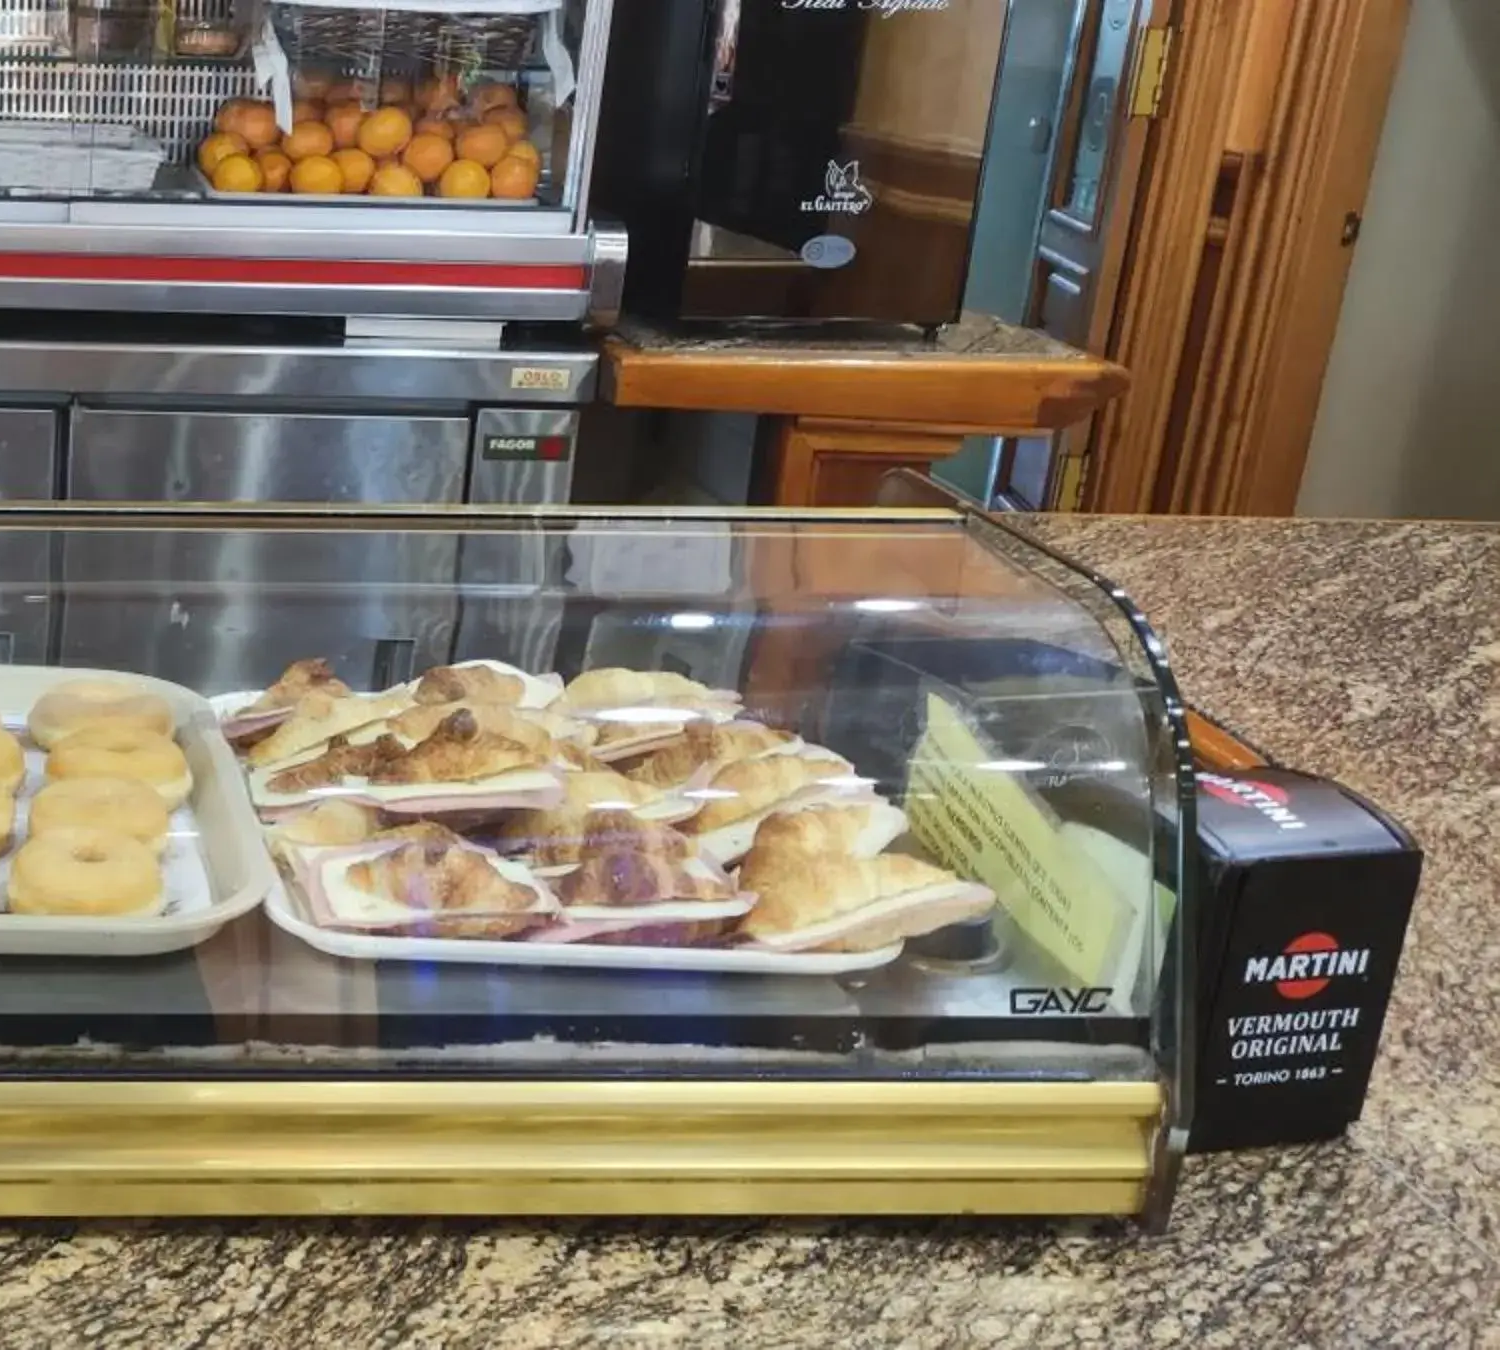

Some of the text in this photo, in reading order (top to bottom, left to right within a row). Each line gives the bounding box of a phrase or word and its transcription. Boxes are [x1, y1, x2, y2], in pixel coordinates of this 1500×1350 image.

[490, 439, 536, 450] FAGOR
[1245, 949, 1371, 983] MARTINI
[1010, 987, 1113, 1014] GAYC
[1227, 1007, 1360, 1037] VERMOUTH
[1232, 1032, 1342, 1059] ORIGINAL
[1234, 1069, 1290, 1085] TORINO
